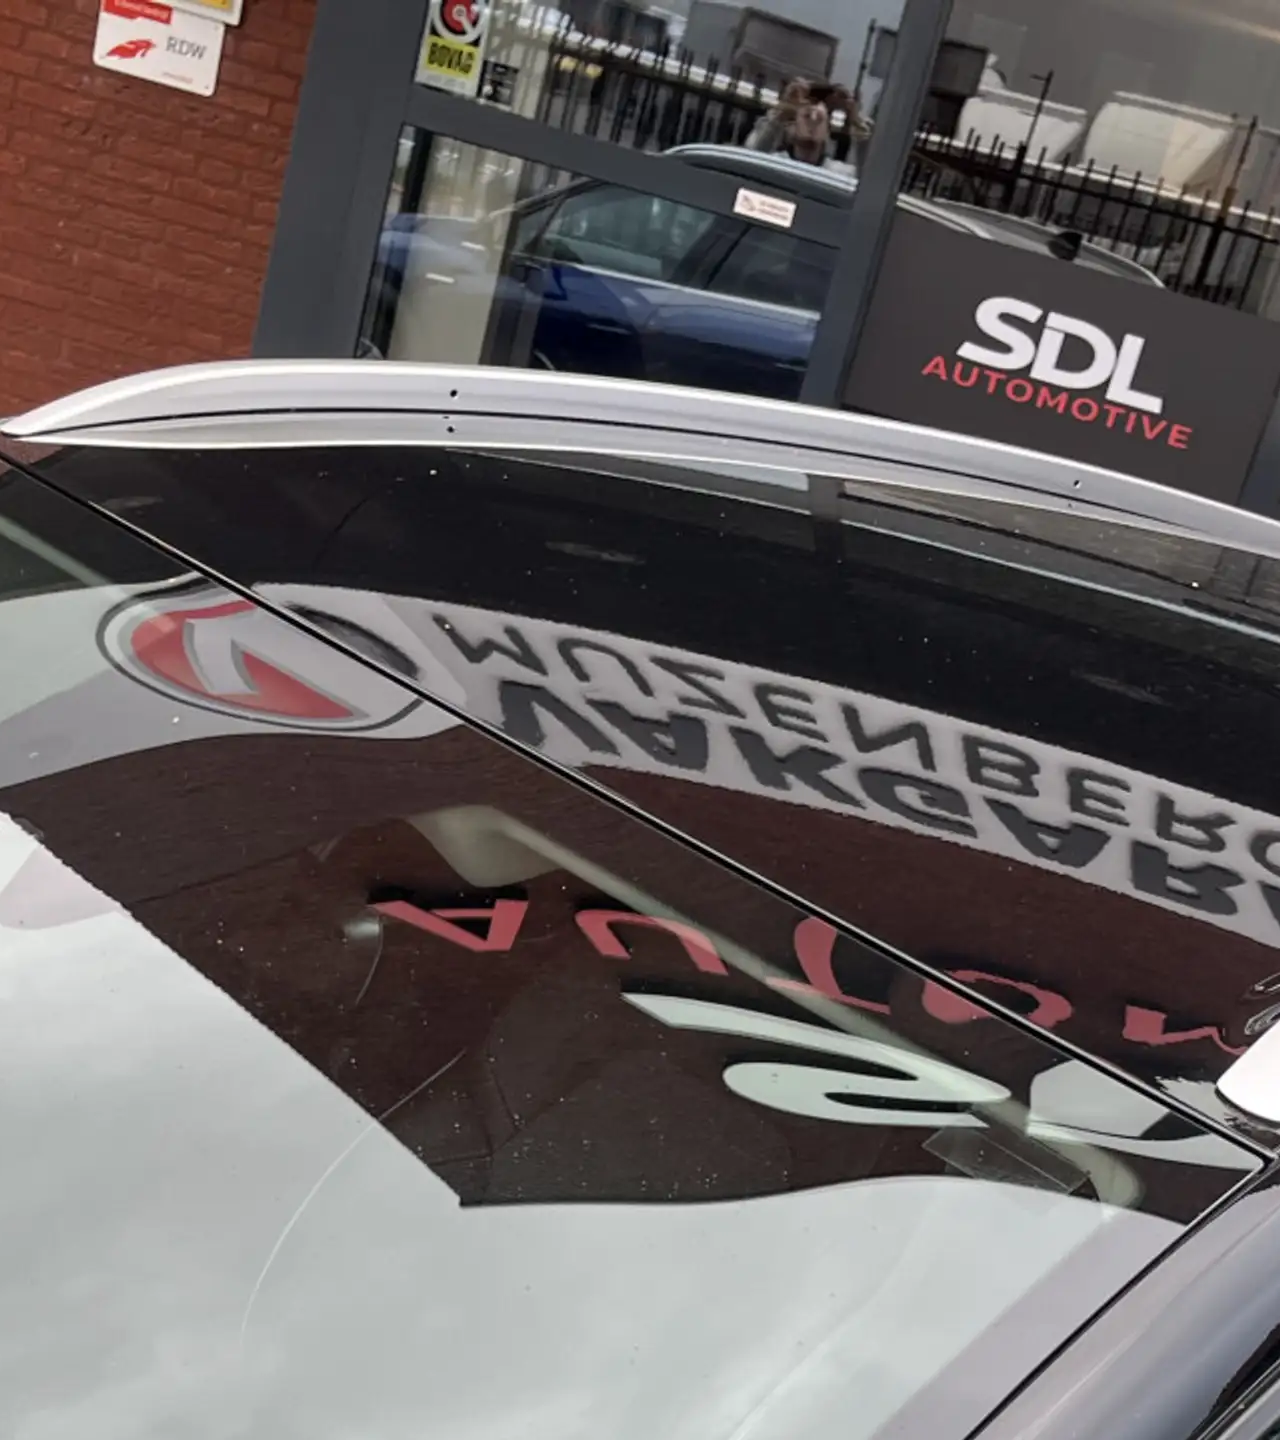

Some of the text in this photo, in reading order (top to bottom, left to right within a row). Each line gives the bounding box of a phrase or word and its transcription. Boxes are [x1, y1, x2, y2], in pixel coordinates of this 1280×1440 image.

[165, 36, 207, 61] RDW
[921, 355, 1193, 449] AUTOMOTIVE
[956, 296, 1163, 414] SDL
